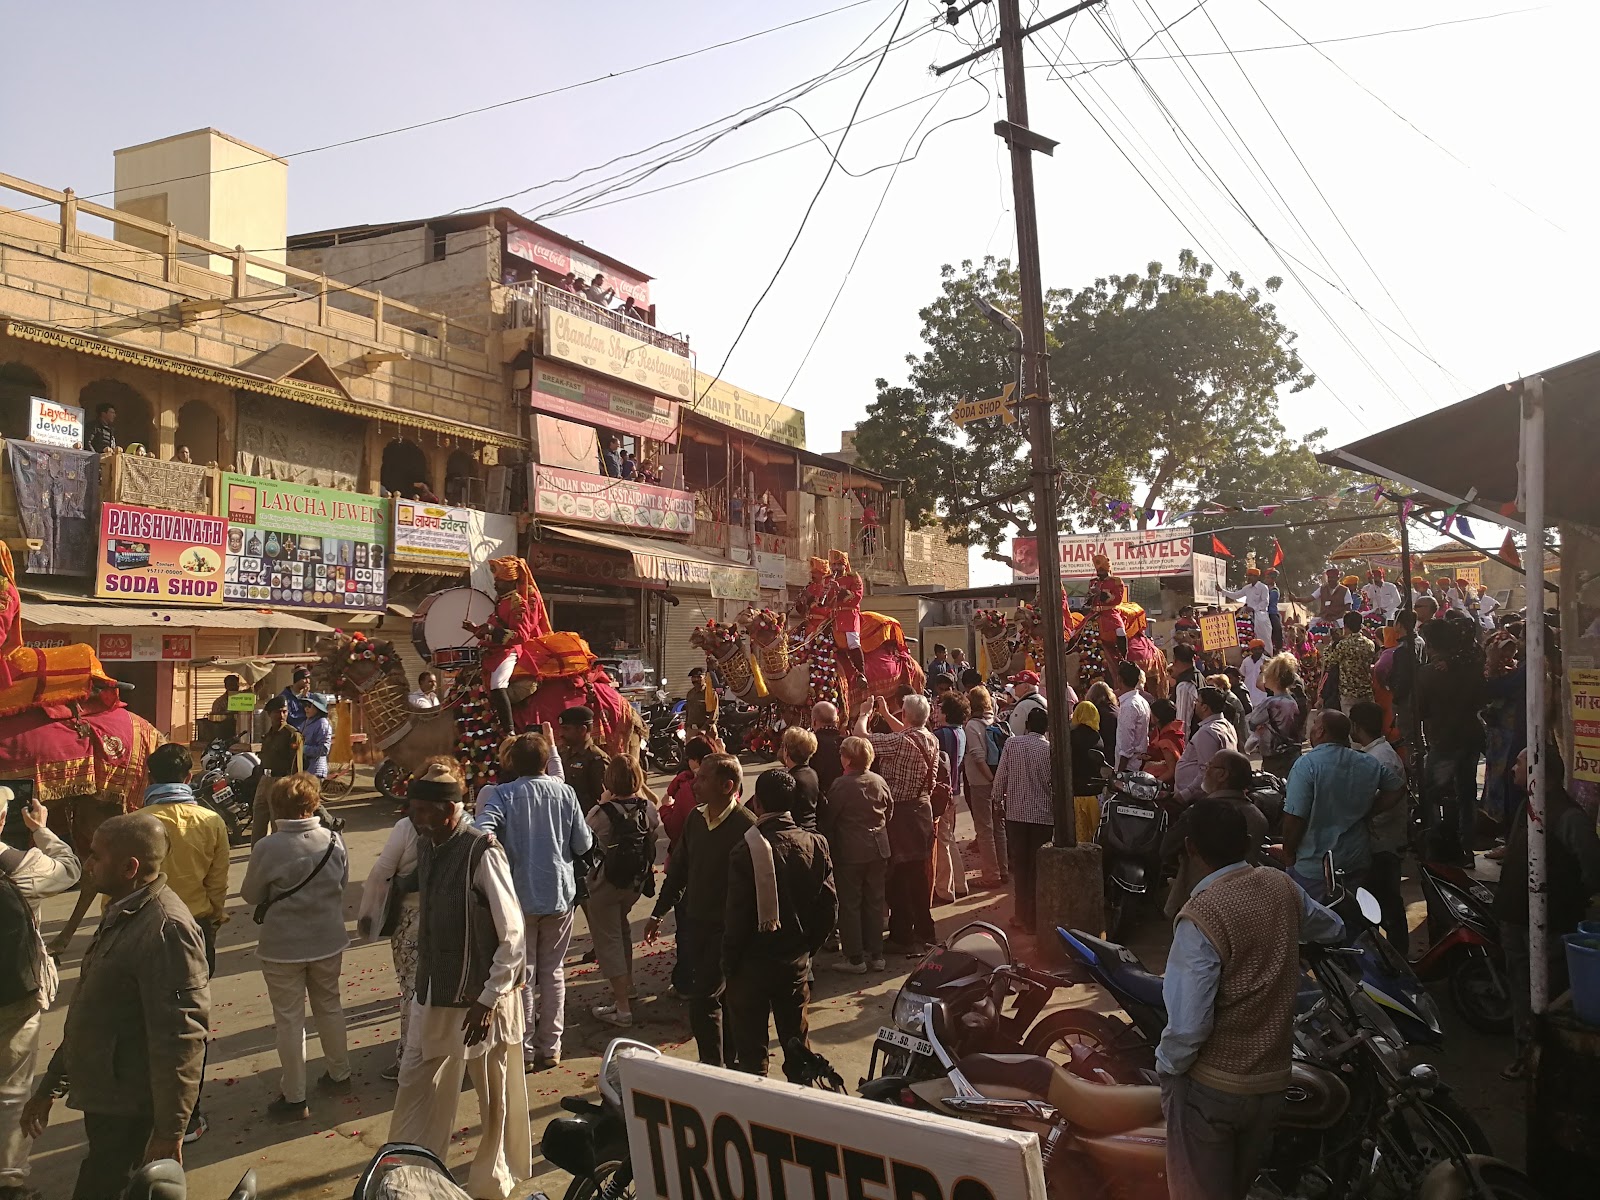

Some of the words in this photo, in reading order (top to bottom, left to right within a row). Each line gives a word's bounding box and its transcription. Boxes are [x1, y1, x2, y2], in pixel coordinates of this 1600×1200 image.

[555, 315, 605, 354] Chandan
[608, 335, 635, 365] Shree
[639, 346, 690, 383] Restaurant
[542, 373, 581, 391] BREAK-FAST
[612, 395, 634, 407] DINNER
[955, 405, 975, 419] SODA
[978, 400, 1000, 415] SHOP
[40, 403, 77, 422] Laycha
[615, 405, 634, 416] SOUTH
[635, 410, 654, 420] INDIAN
[734, 402, 761, 427] KILLA
[764, 413, 798, 439] CORNER
[37, 417, 79, 437] Jewels
[538, 473, 579, 493] CHANDAN
[580, 481, 607, 500] SHREE
[608, 486, 657, 508] RESTAURANT
[665, 496, 693, 513] SWEETS
[261, 490, 327, 517] LAYCHA
[330, 501, 384, 525] JEWELS
[108, 509, 223, 545] PARSHVANATH
[1113, 537, 1191, 560] TRAVELS
[105, 574, 160, 594] SODA
[168, 578, 218, 596] SHOP
[1205, 635, 1235, 645] CARAVAN
[631, 1088, 997, 1200] TROTTE
